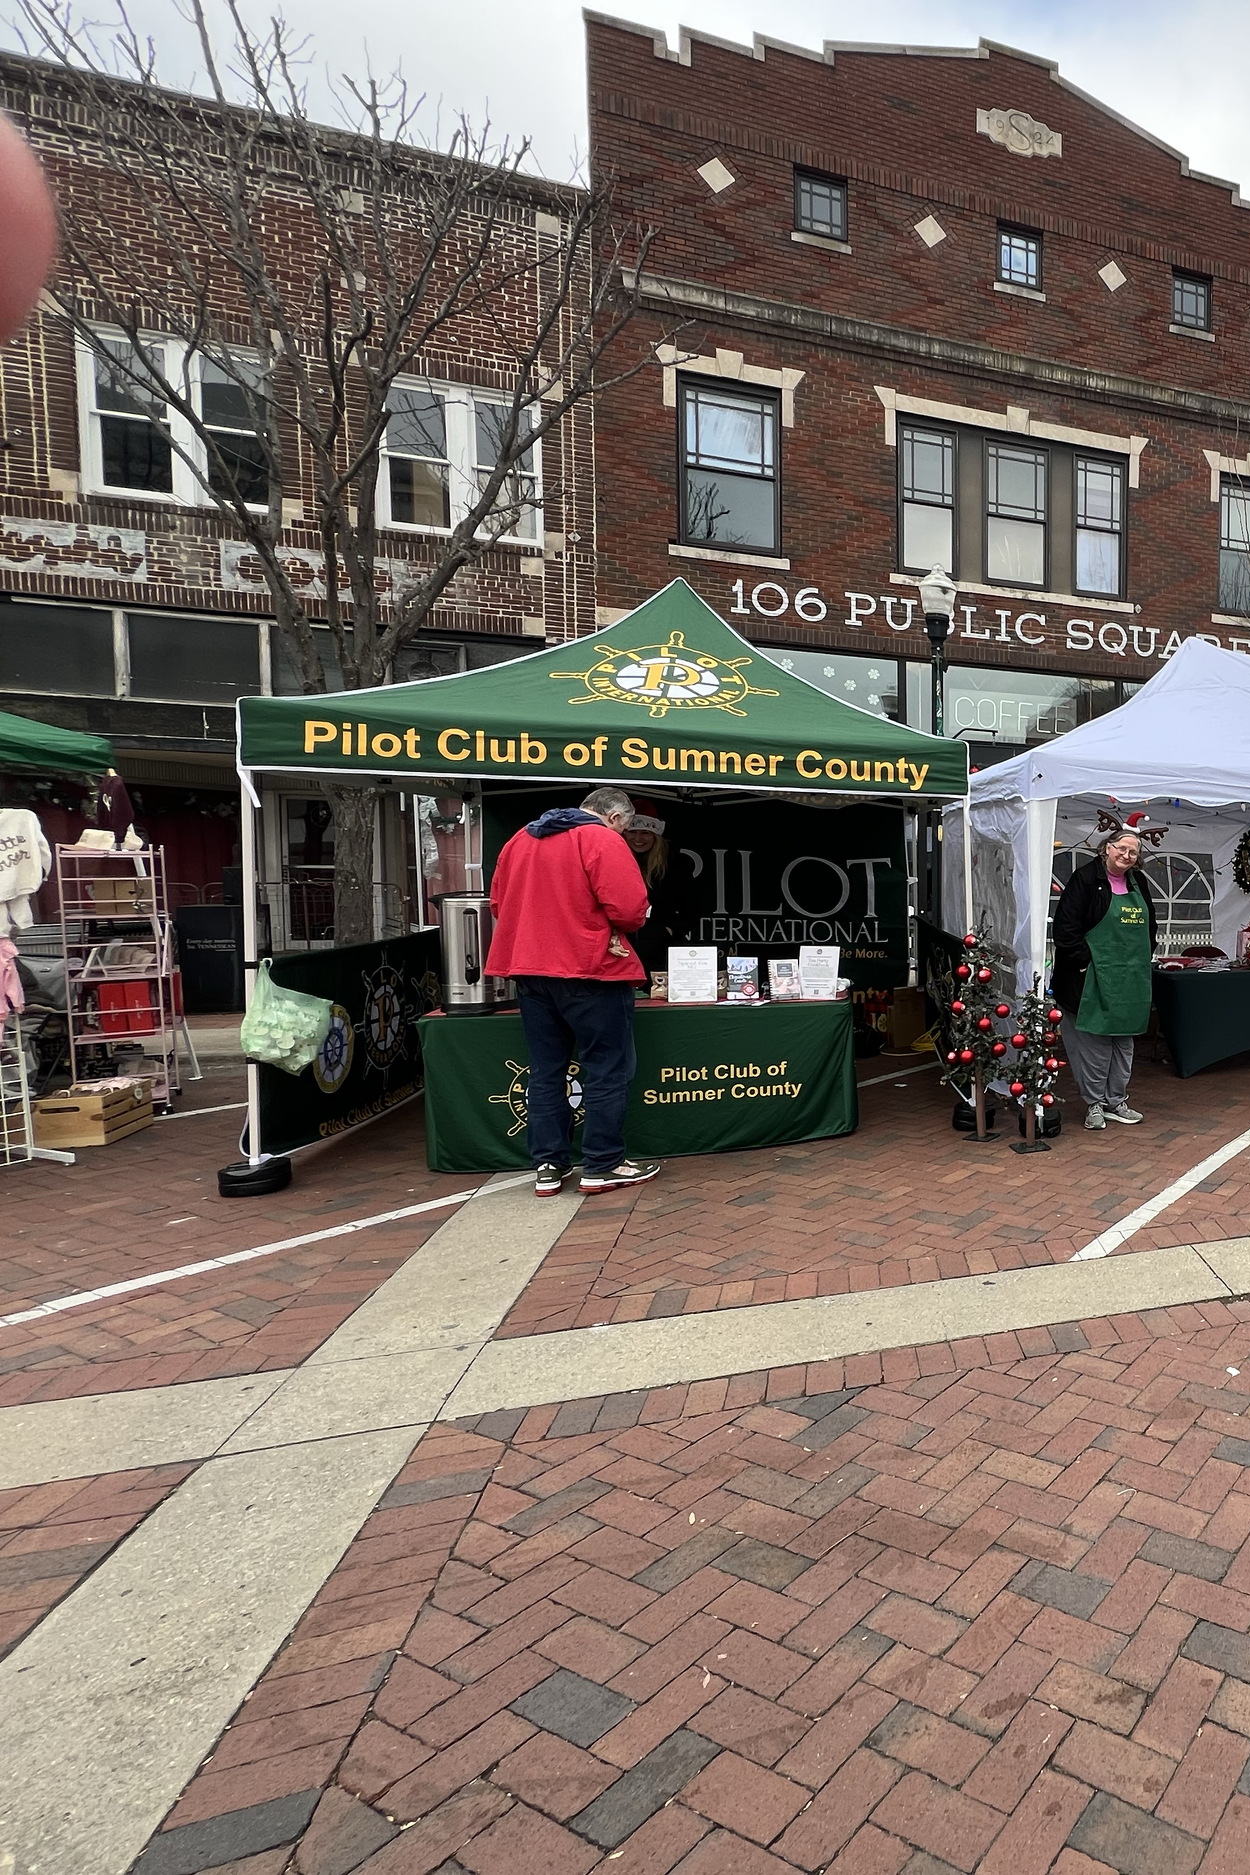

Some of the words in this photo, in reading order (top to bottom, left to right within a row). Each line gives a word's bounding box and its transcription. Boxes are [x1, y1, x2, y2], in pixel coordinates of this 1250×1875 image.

[1008, 113, 1031, 151] S
[730, 579, 828, 622] 106
[596, 646, 743, 685] PILOT
[591, 677, 741, 707] INTERNATIONAL
[955, 696, 1070, 735] COFFEE
[304, 720, 422, 759] Pilot
[437, 728, 548, 765] Club
[563, 736, 609, 767] of
[620, 738, 785, 777] Sumner
[796, 750, 930, 791] County
[855, 948, 888, 959] More.
[661, 1066, 709, 1083] Pilot
[714, 1063, 762, 1080] Club
[767, 1060, 788, 1076] of
[319, 1111, 349, 1137] Pilot
[347, 1102, 373, 1127] Club
[372, 1093, 385, 1112] of
[384, 1081, 416, 1107] Sumner
[643, 1087, 726, 1105] Sumner
[731, 1081, 802, 1098] County
